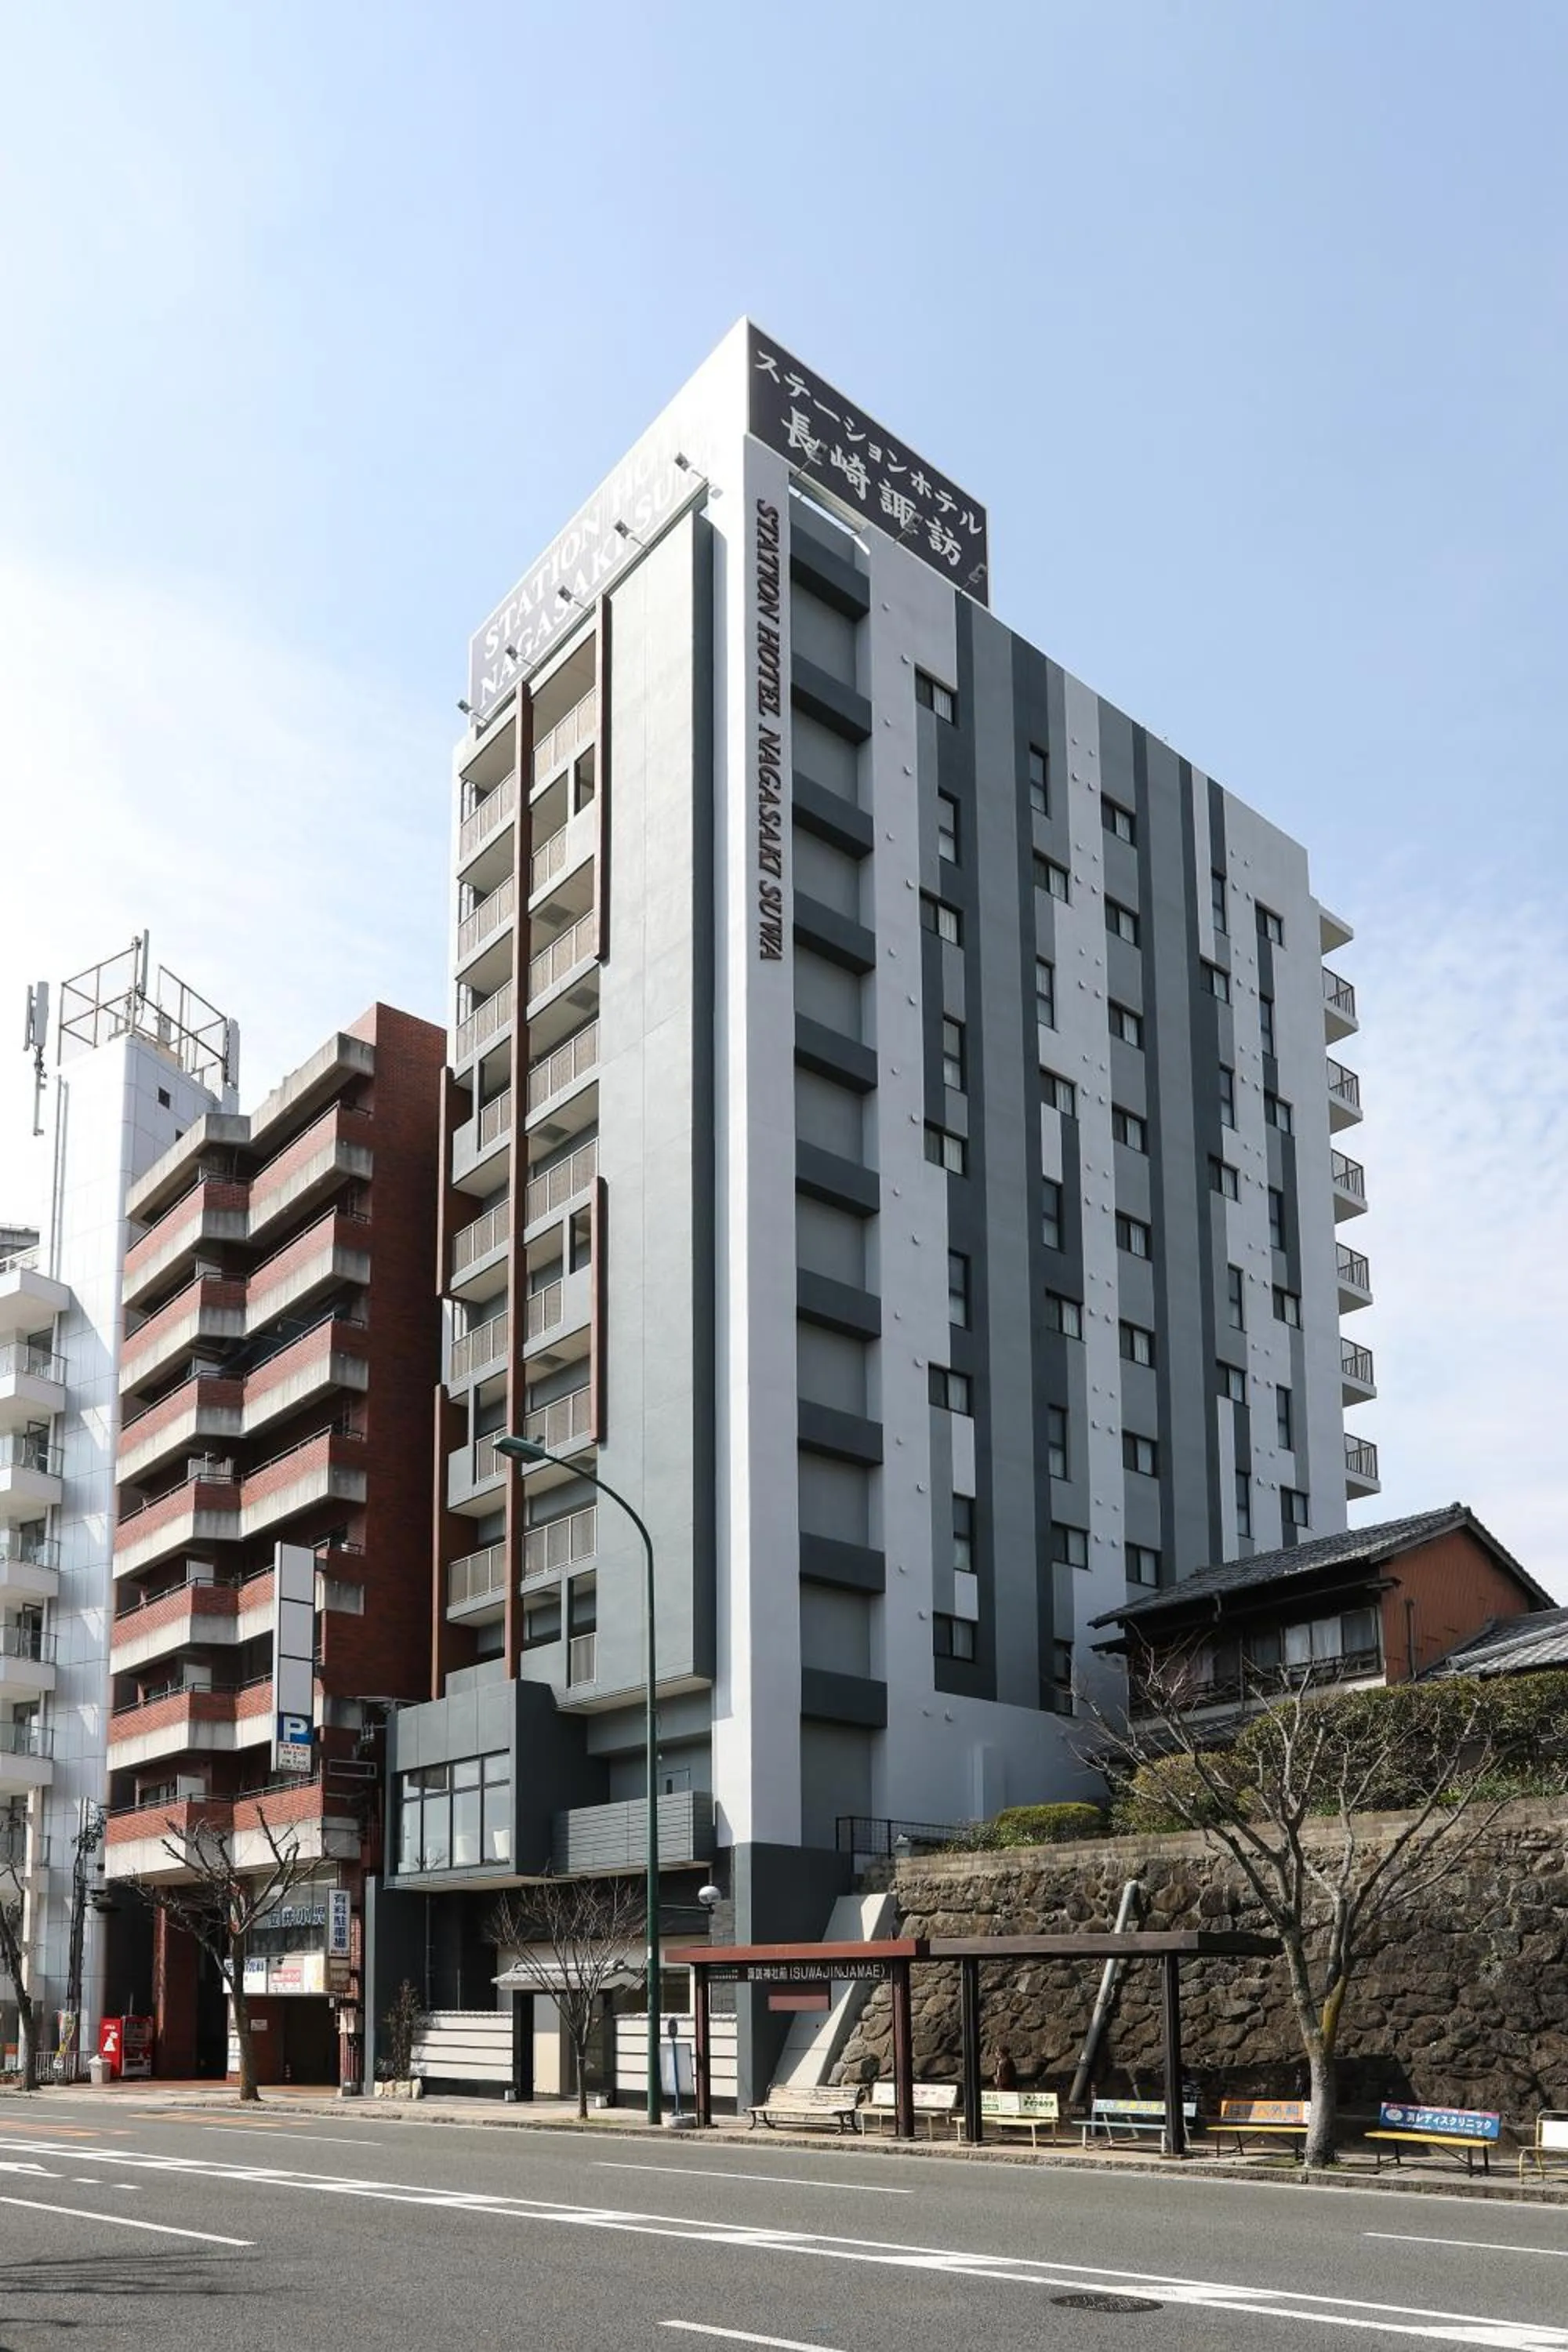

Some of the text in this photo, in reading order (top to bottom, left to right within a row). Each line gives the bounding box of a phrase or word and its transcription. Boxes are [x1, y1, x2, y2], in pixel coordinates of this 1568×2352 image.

[755, 350, 983, 535] ステーションホテル
[781, 406, 963, 567] 長崎諏訪
[479, 527, 629, 710] NAGASAKI
[484, 502, 604, 660] STATION
[757, 497, 783, 960] STATION HOTEL NAGASAKI SUWA
[283, 1715, 309, 1742] P
